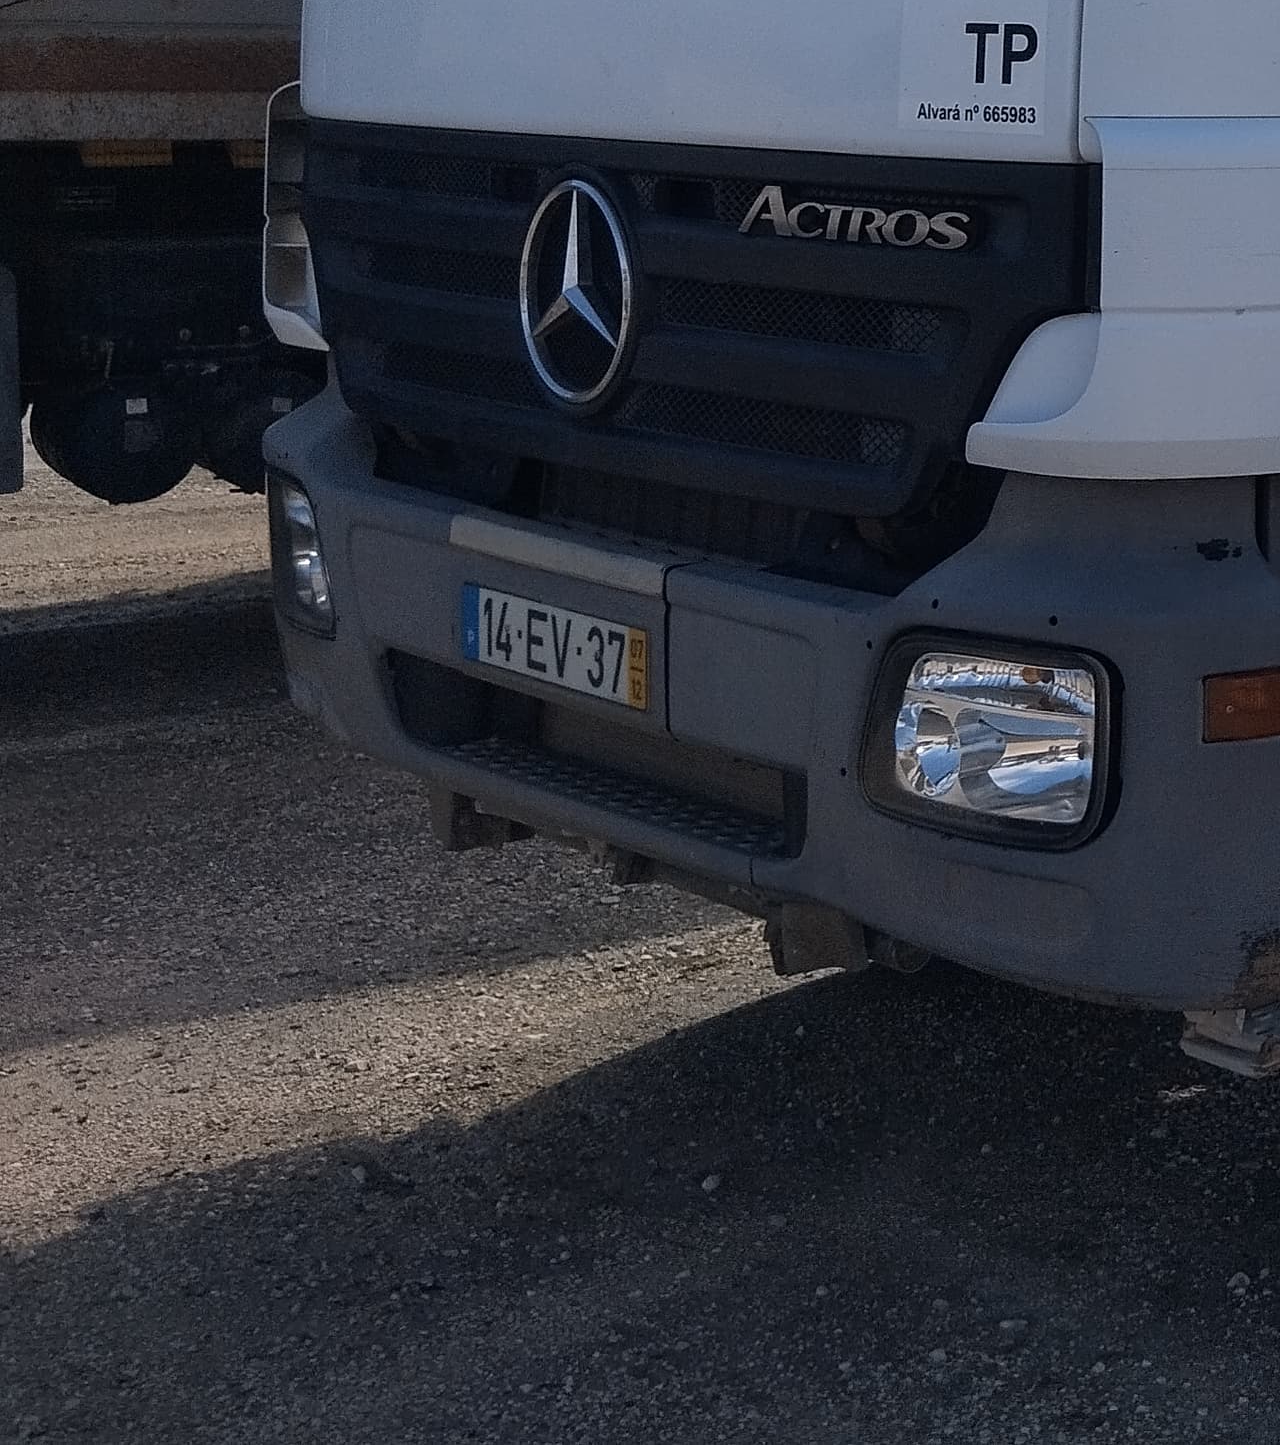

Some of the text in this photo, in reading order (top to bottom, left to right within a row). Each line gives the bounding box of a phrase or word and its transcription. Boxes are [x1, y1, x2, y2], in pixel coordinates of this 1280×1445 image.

[965, 22, 1038, 85] TP
[917, 103, 961, 121] Alvará
[983, 105, 1036, 124] 665983
